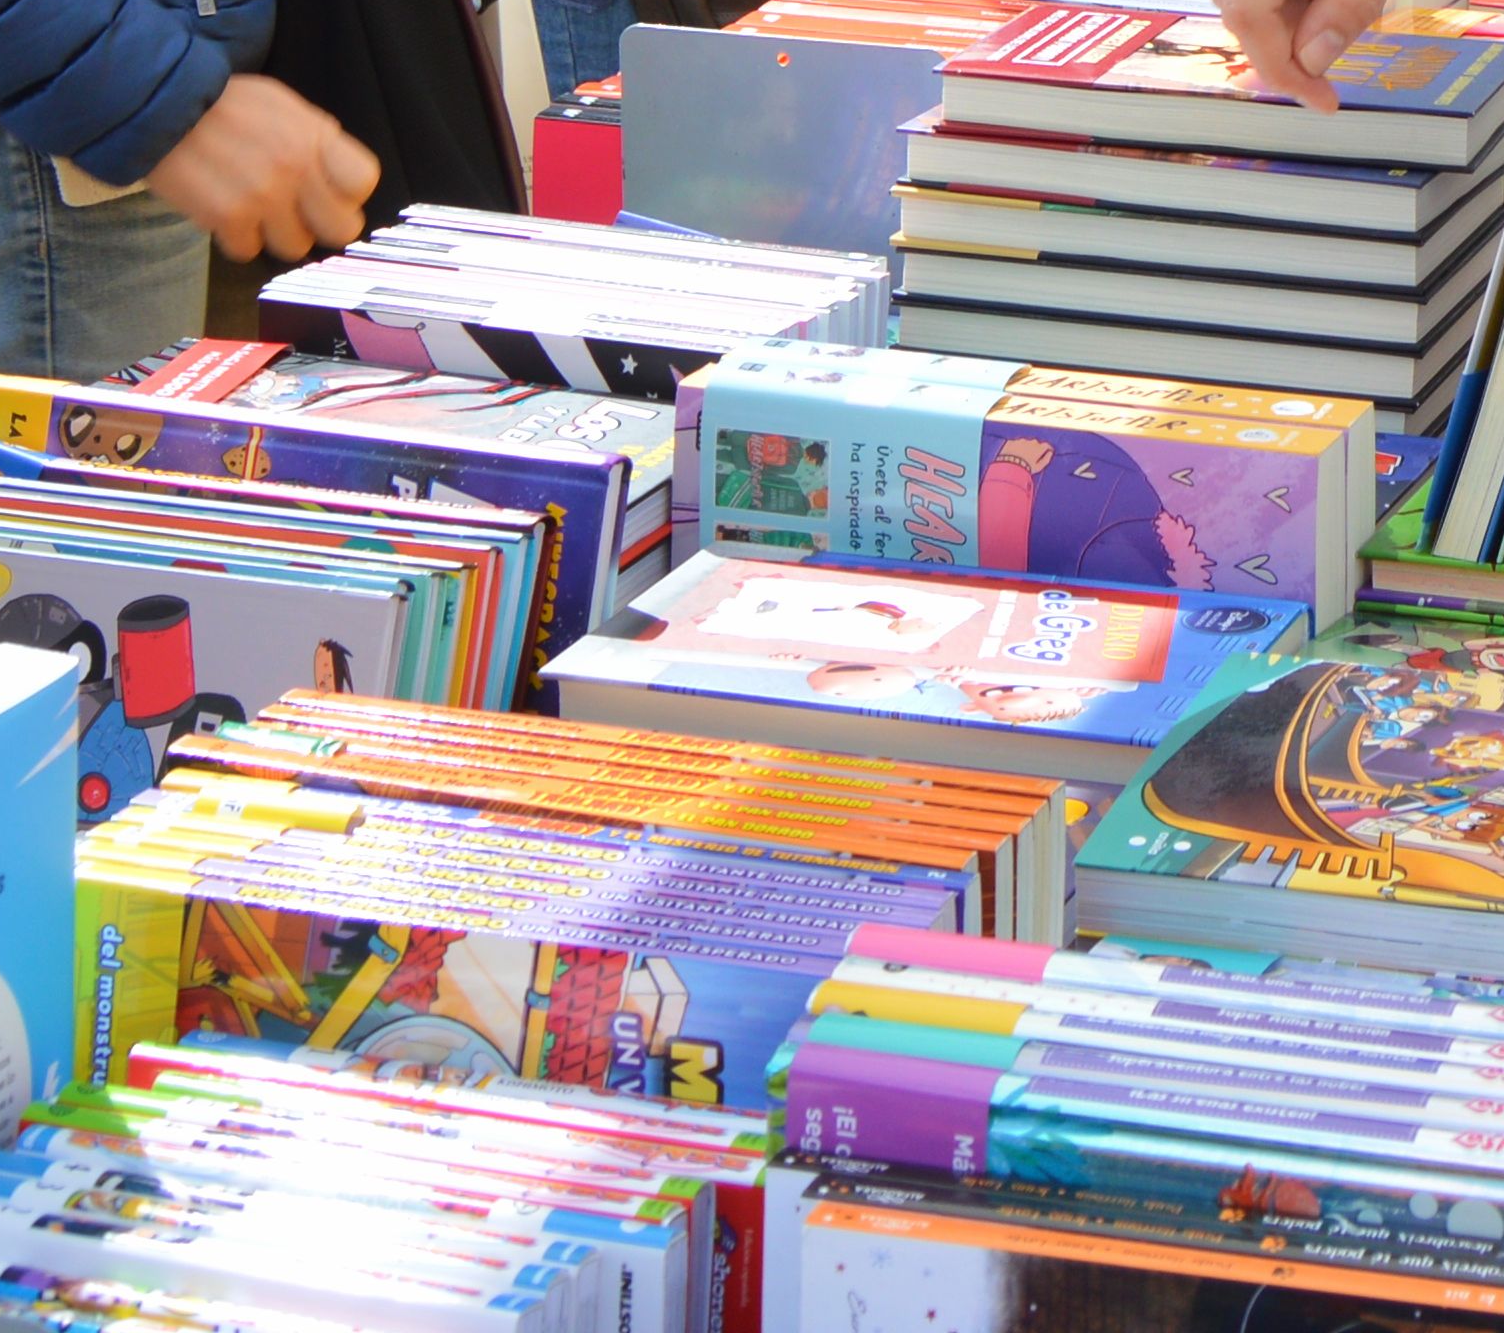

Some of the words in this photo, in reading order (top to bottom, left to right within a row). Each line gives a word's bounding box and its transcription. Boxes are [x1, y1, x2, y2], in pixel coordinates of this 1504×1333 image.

[850, 442, 867, 463] ha
[873, 445, 894, 498] Únete
[846, 470, 866, 551] inspirado
[874, 504, 893, 524] al
[1103, 604, 1145, 661] DIARIO
[787, 750, 824, 762] PAN
[826, 754, 897, 771] DORADO
[776, 769, 813, 782] PAN
[816, 774, 889, 791] DORADO
[761, 787, 798, 800] PAN
[800, 792, 874, 809] DORADO
[735, 805, 772, 817] PAN
[775, 810, 849, 827] DORADO
[702, 816, 740, 829] PAN
[741, 822, 816, 841] DORADO
[647, 834, 741, 854] MISTERIO
[633, 856, 663, 867] UN
[665, 860, 768, 880] VISITANTE
[773, 875, 905, 897] INESPERADO
[620, 873, 651, 885] UN
[655, 877, 758, 899] VISITANTE
[761, 890, 893, 915] INESPERADO
[599, 891, 630, 903] UN
[634, 894, 737, 918] VISITANTE
[741, 908, 856, 932] INESPERAD
[544, 903, 577, 917] UN
[579, 908, 683, 934] VISITANTE
[687, 923, 822, 946] INESPERADO
[100, 923, 124, 970] del
[519, 923, 555, 935] UN
[557, 926, 662, 954] VISITANTE
[664, 942, 800, 966] INESPERADO
[1260, 1212, 1323, 1234] poders
[1366, 1223, 1391, 1238] que
[1304, 1241, 1364, 1265] poders
[1403, 1230, 1494, 1254] descobreix
[1399, 1253, 1434, 1269] que
